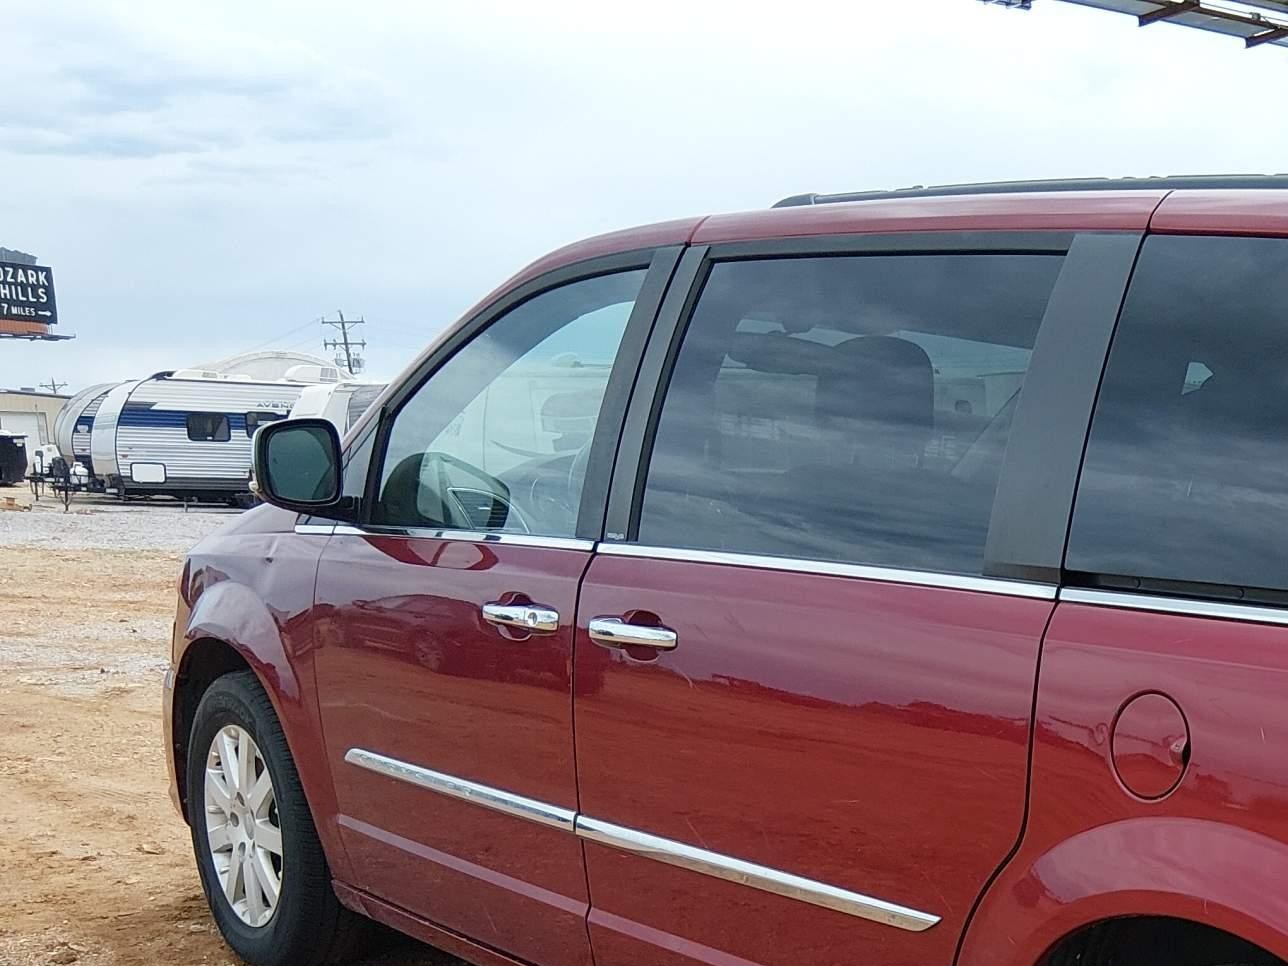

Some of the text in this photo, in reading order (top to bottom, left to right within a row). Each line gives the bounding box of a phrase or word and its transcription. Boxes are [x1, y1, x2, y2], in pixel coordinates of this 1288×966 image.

[0, 284, 47, 302] HILLS
[1, 303, 36, 316] 7 MILES
